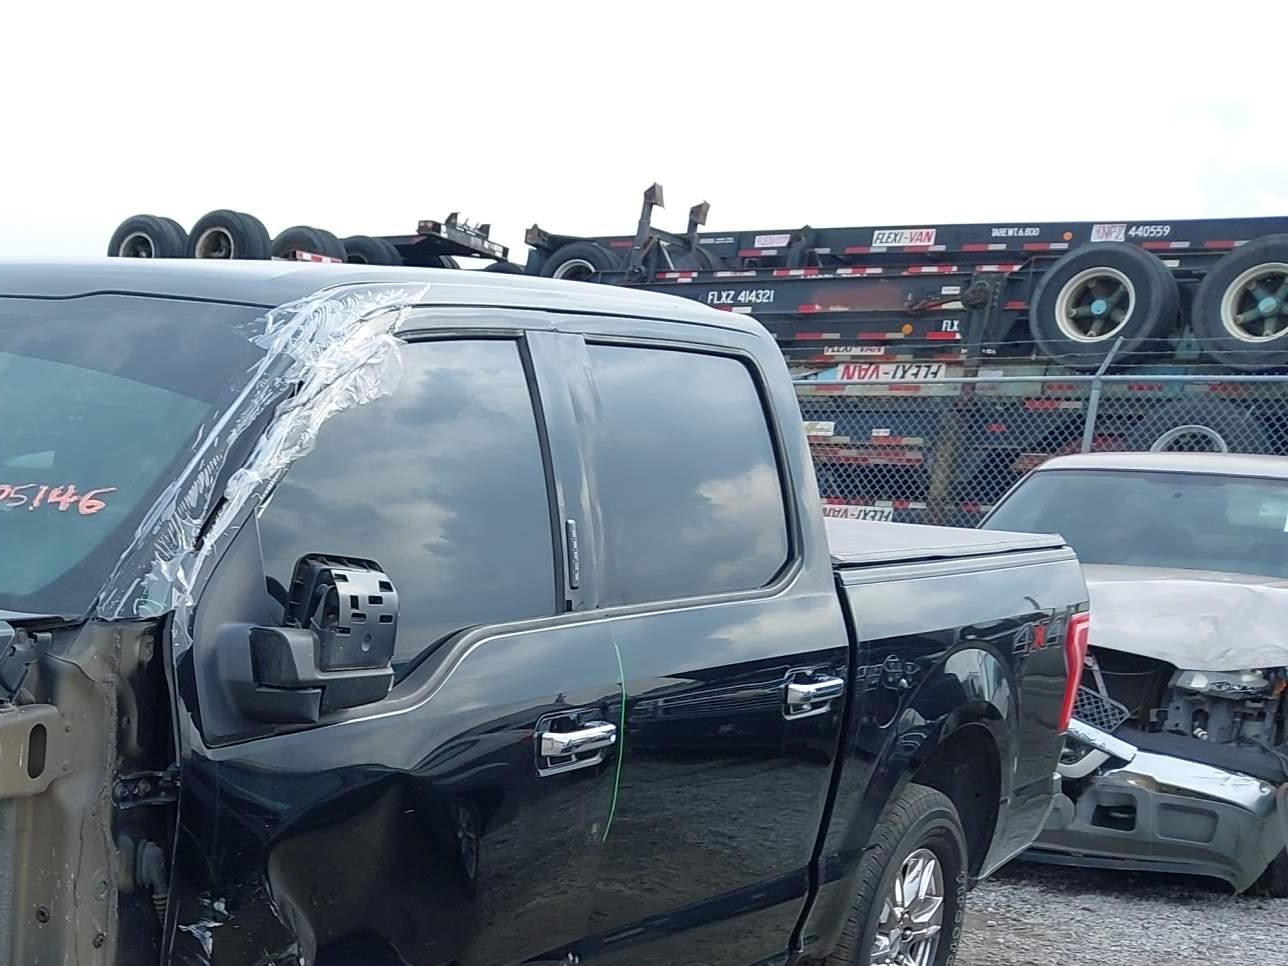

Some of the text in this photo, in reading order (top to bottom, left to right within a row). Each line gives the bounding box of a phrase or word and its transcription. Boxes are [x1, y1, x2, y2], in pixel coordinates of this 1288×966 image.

[873, 231, 934, 245] FLEXI-VAN
[1128, 225, 1171, 237] 440559
[707, 289, 774, 304] FLXZ 414321
[841, 364, 943, 379] FLEXI-VAN
